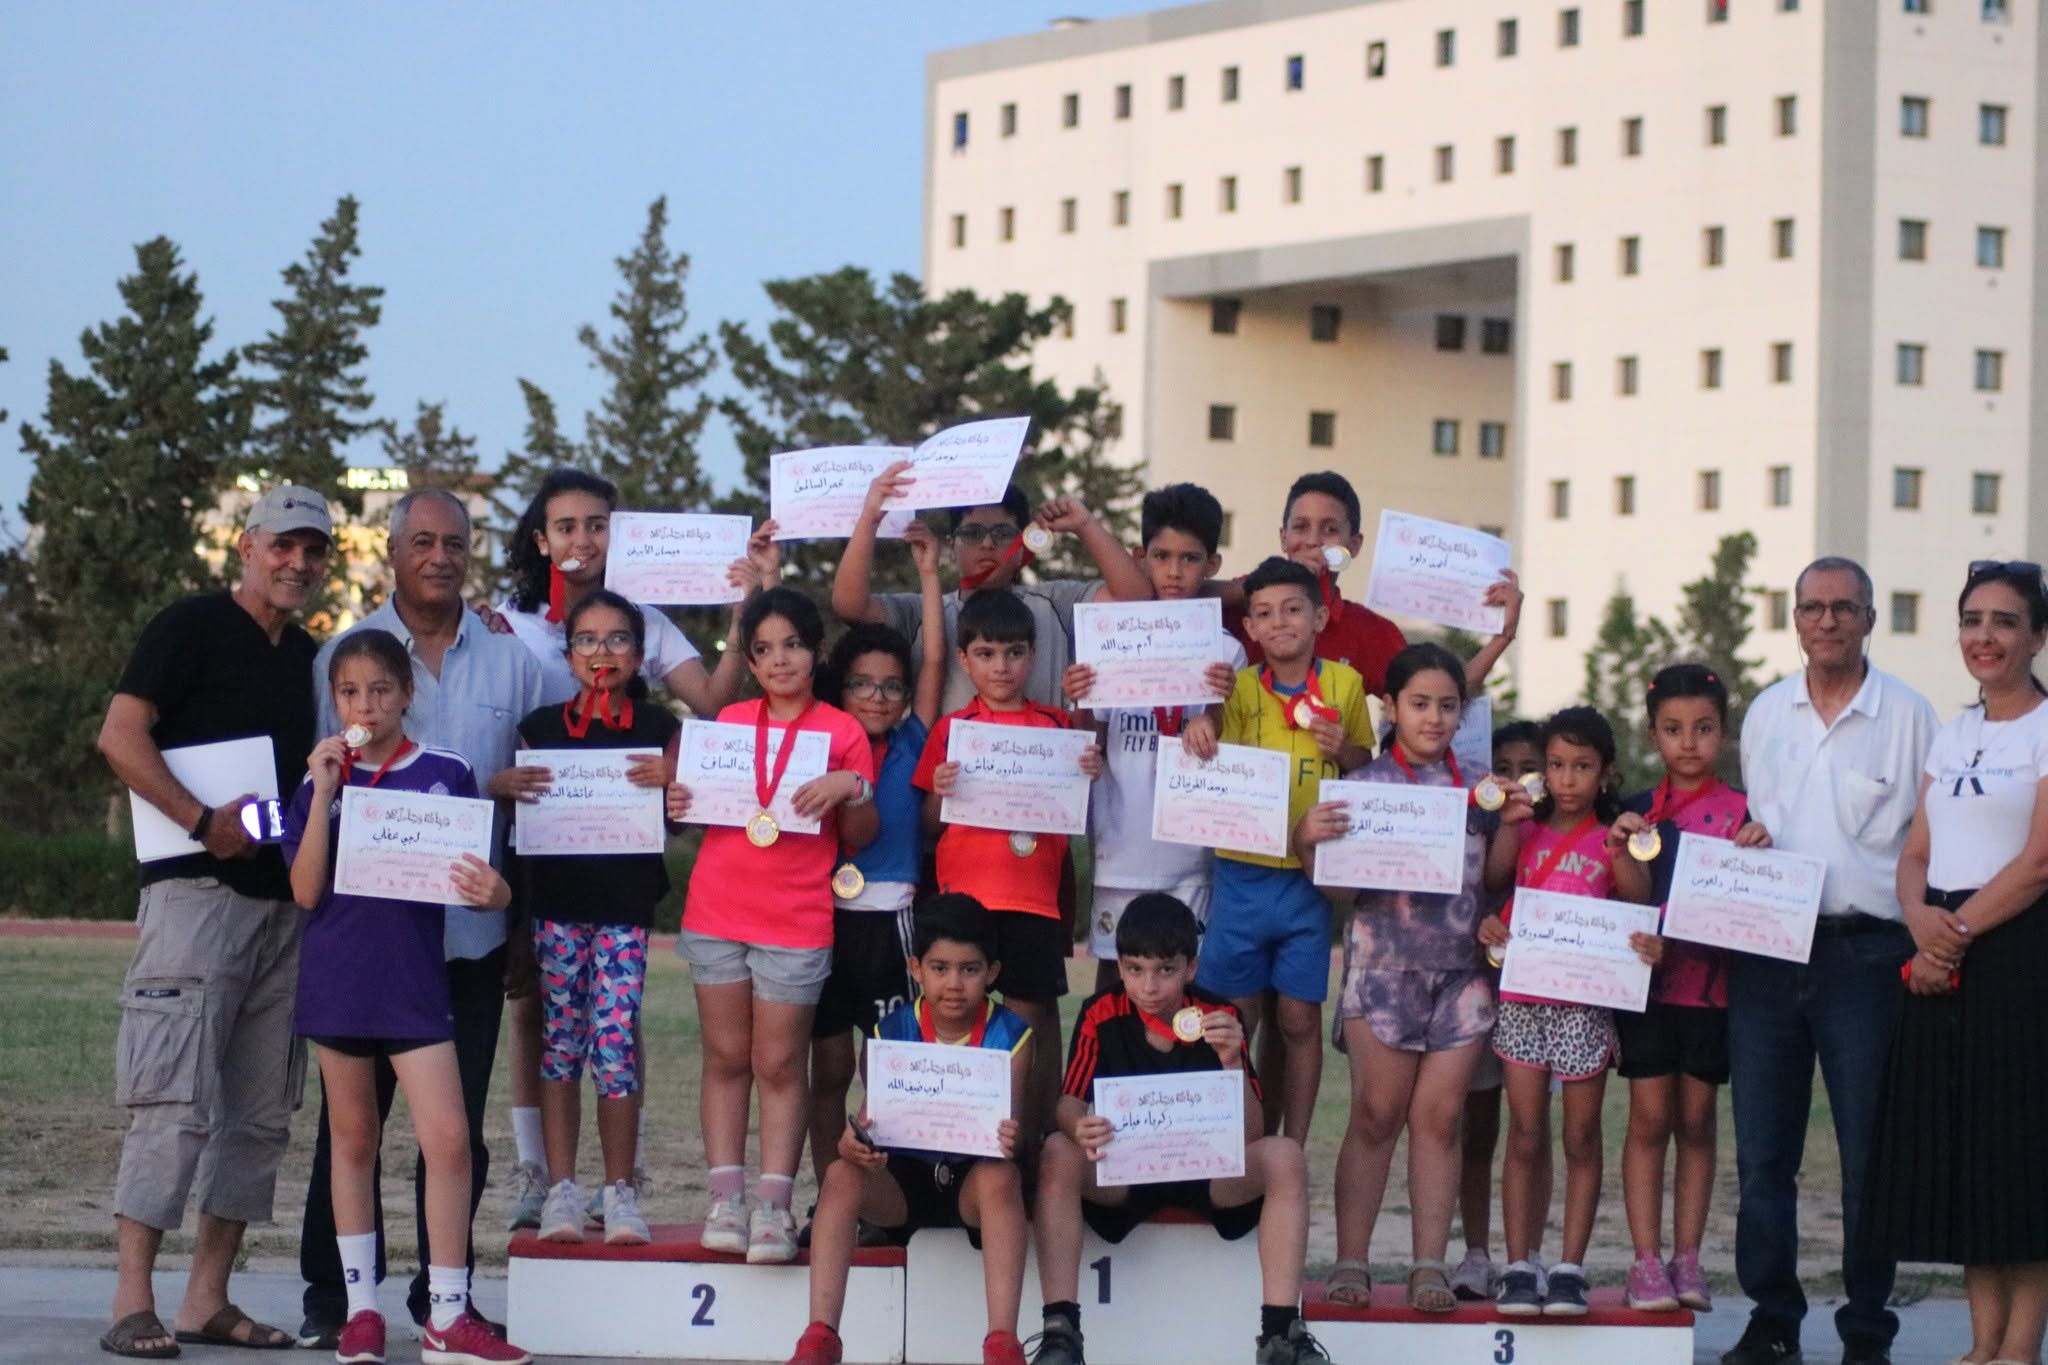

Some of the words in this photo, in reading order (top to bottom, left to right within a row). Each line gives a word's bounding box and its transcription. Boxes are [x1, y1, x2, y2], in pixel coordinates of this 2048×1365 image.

[1124, 735, 1145, 752] FLY
[1149, 735, 1159, 752] B
[888, 1078, 903, 1089] الله
[1090, 1256, 1111, 1304] 1
[691, 1283, 716, 1326] 2
[1494, 1329, 1515, 1364] 3
